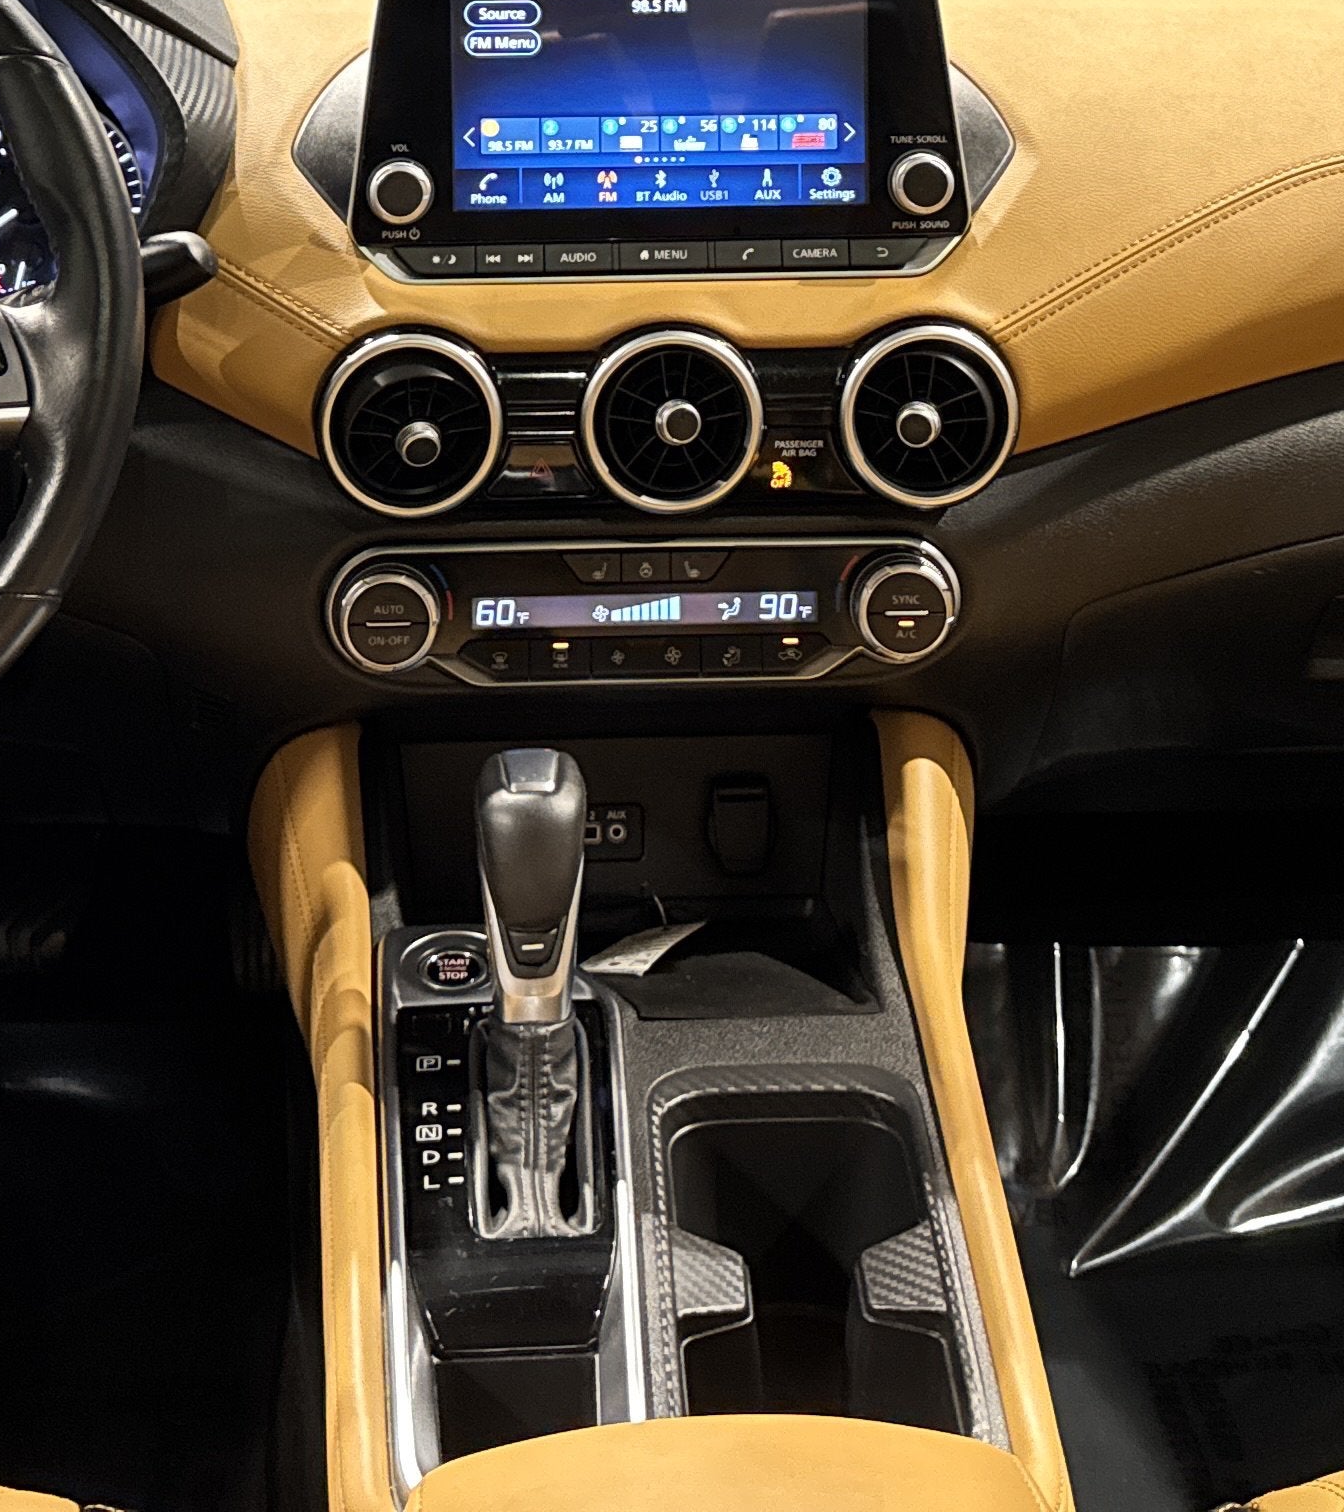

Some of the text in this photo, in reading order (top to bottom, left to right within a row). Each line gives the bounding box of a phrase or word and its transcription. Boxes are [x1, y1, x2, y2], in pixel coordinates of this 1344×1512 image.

[631, 0, 688, 13] 98.5 FM
[478, 7, 527, 21] Source
[469, 36, 536, 50] FM Menu
[640, 119, 658, 133] 25
[699, 119, 718, 133] 56
[751, 118, 777, 132] 114
[817, 117, 837, 131] 80
[390, 143, 410, 153] VOL
[514, 140, 534, 151] FM
[547, 139, 594, 151] 93.7 FM
[470, 192, 508, 205] Phone
[543, 192, 565, 203] AM
[598, 191, 618, 202] FM
[635, 190, 688, 202] BT Audio
[700, 190, 729, 201] USB1
[754, 189, 782, 200] AUX
[808, 188, 856, 203] Settings
[891, 219, 950, 230] PUSH SOUND
[381, 230, 407, 240] PUSH
[559, 251, 597, 263] AUDIO
[653, 249, 688, 261] MENU
[792, 248, 838, 259] CAMERA
[774, 440, 824, 449] PASSENGER
[781, 448, 818, 458] AIR BAG
[770, 478, 792, 489] OFF
[891, 594, 921, 606] SYNC
[373, 603, 404, 615] AUTO
[895, 629, 917, 640] A/C
[436, 957, 471, 967] START
[438, 971, 469, 981] STOP
[422, 1057, 437, 1070] P
[421, 1101, 439, 1117] R
[420, 1126, 438, 1139] N
[422, 1149, 441, 1166] D
[423, 1175, 441, 1191] L
